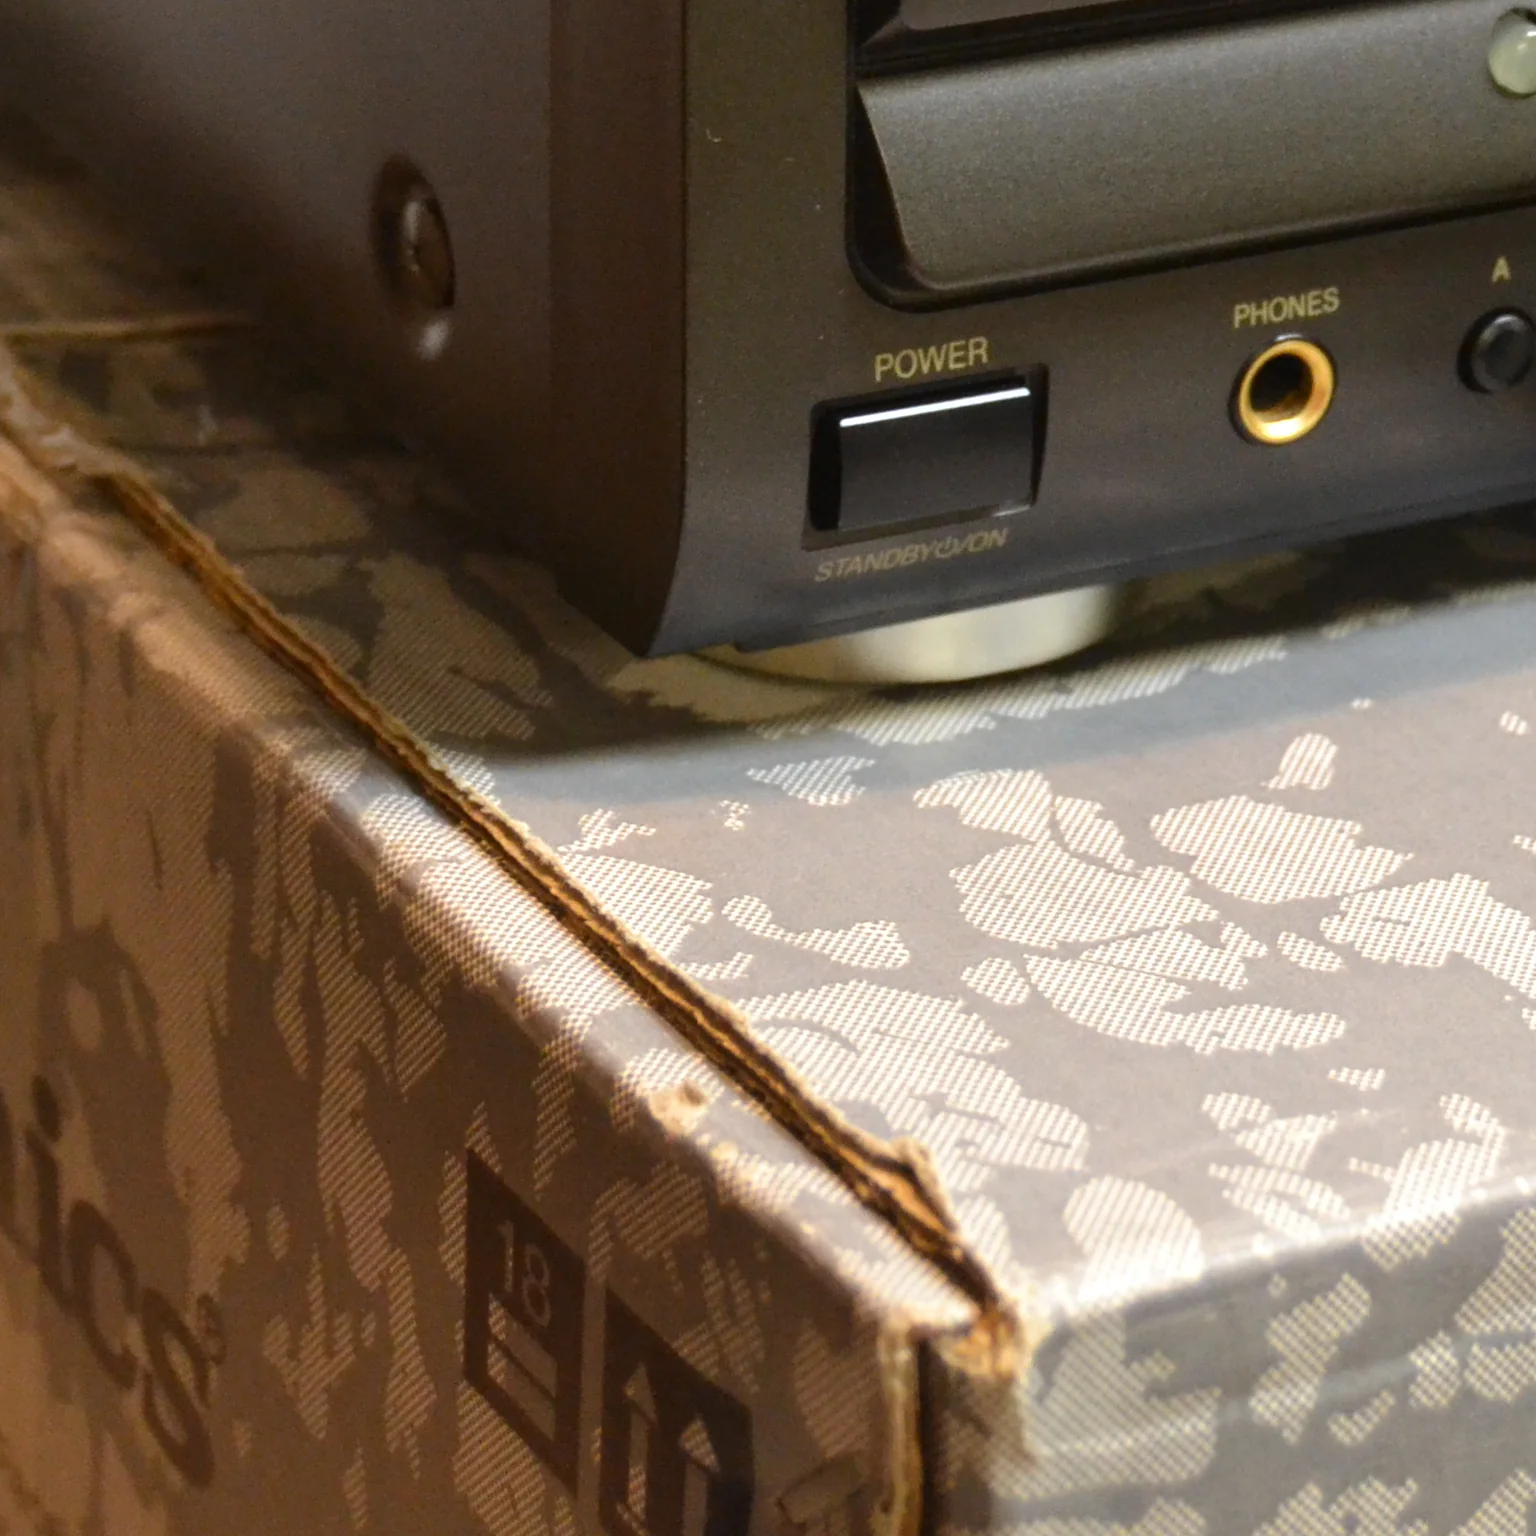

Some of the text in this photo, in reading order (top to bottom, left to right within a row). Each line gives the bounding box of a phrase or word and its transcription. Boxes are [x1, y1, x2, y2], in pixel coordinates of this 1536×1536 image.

[1490, 256, 1512, 283] A
[1232, 286, 1342, 327] PHONES
[873, 336, 990, 381] POWER
